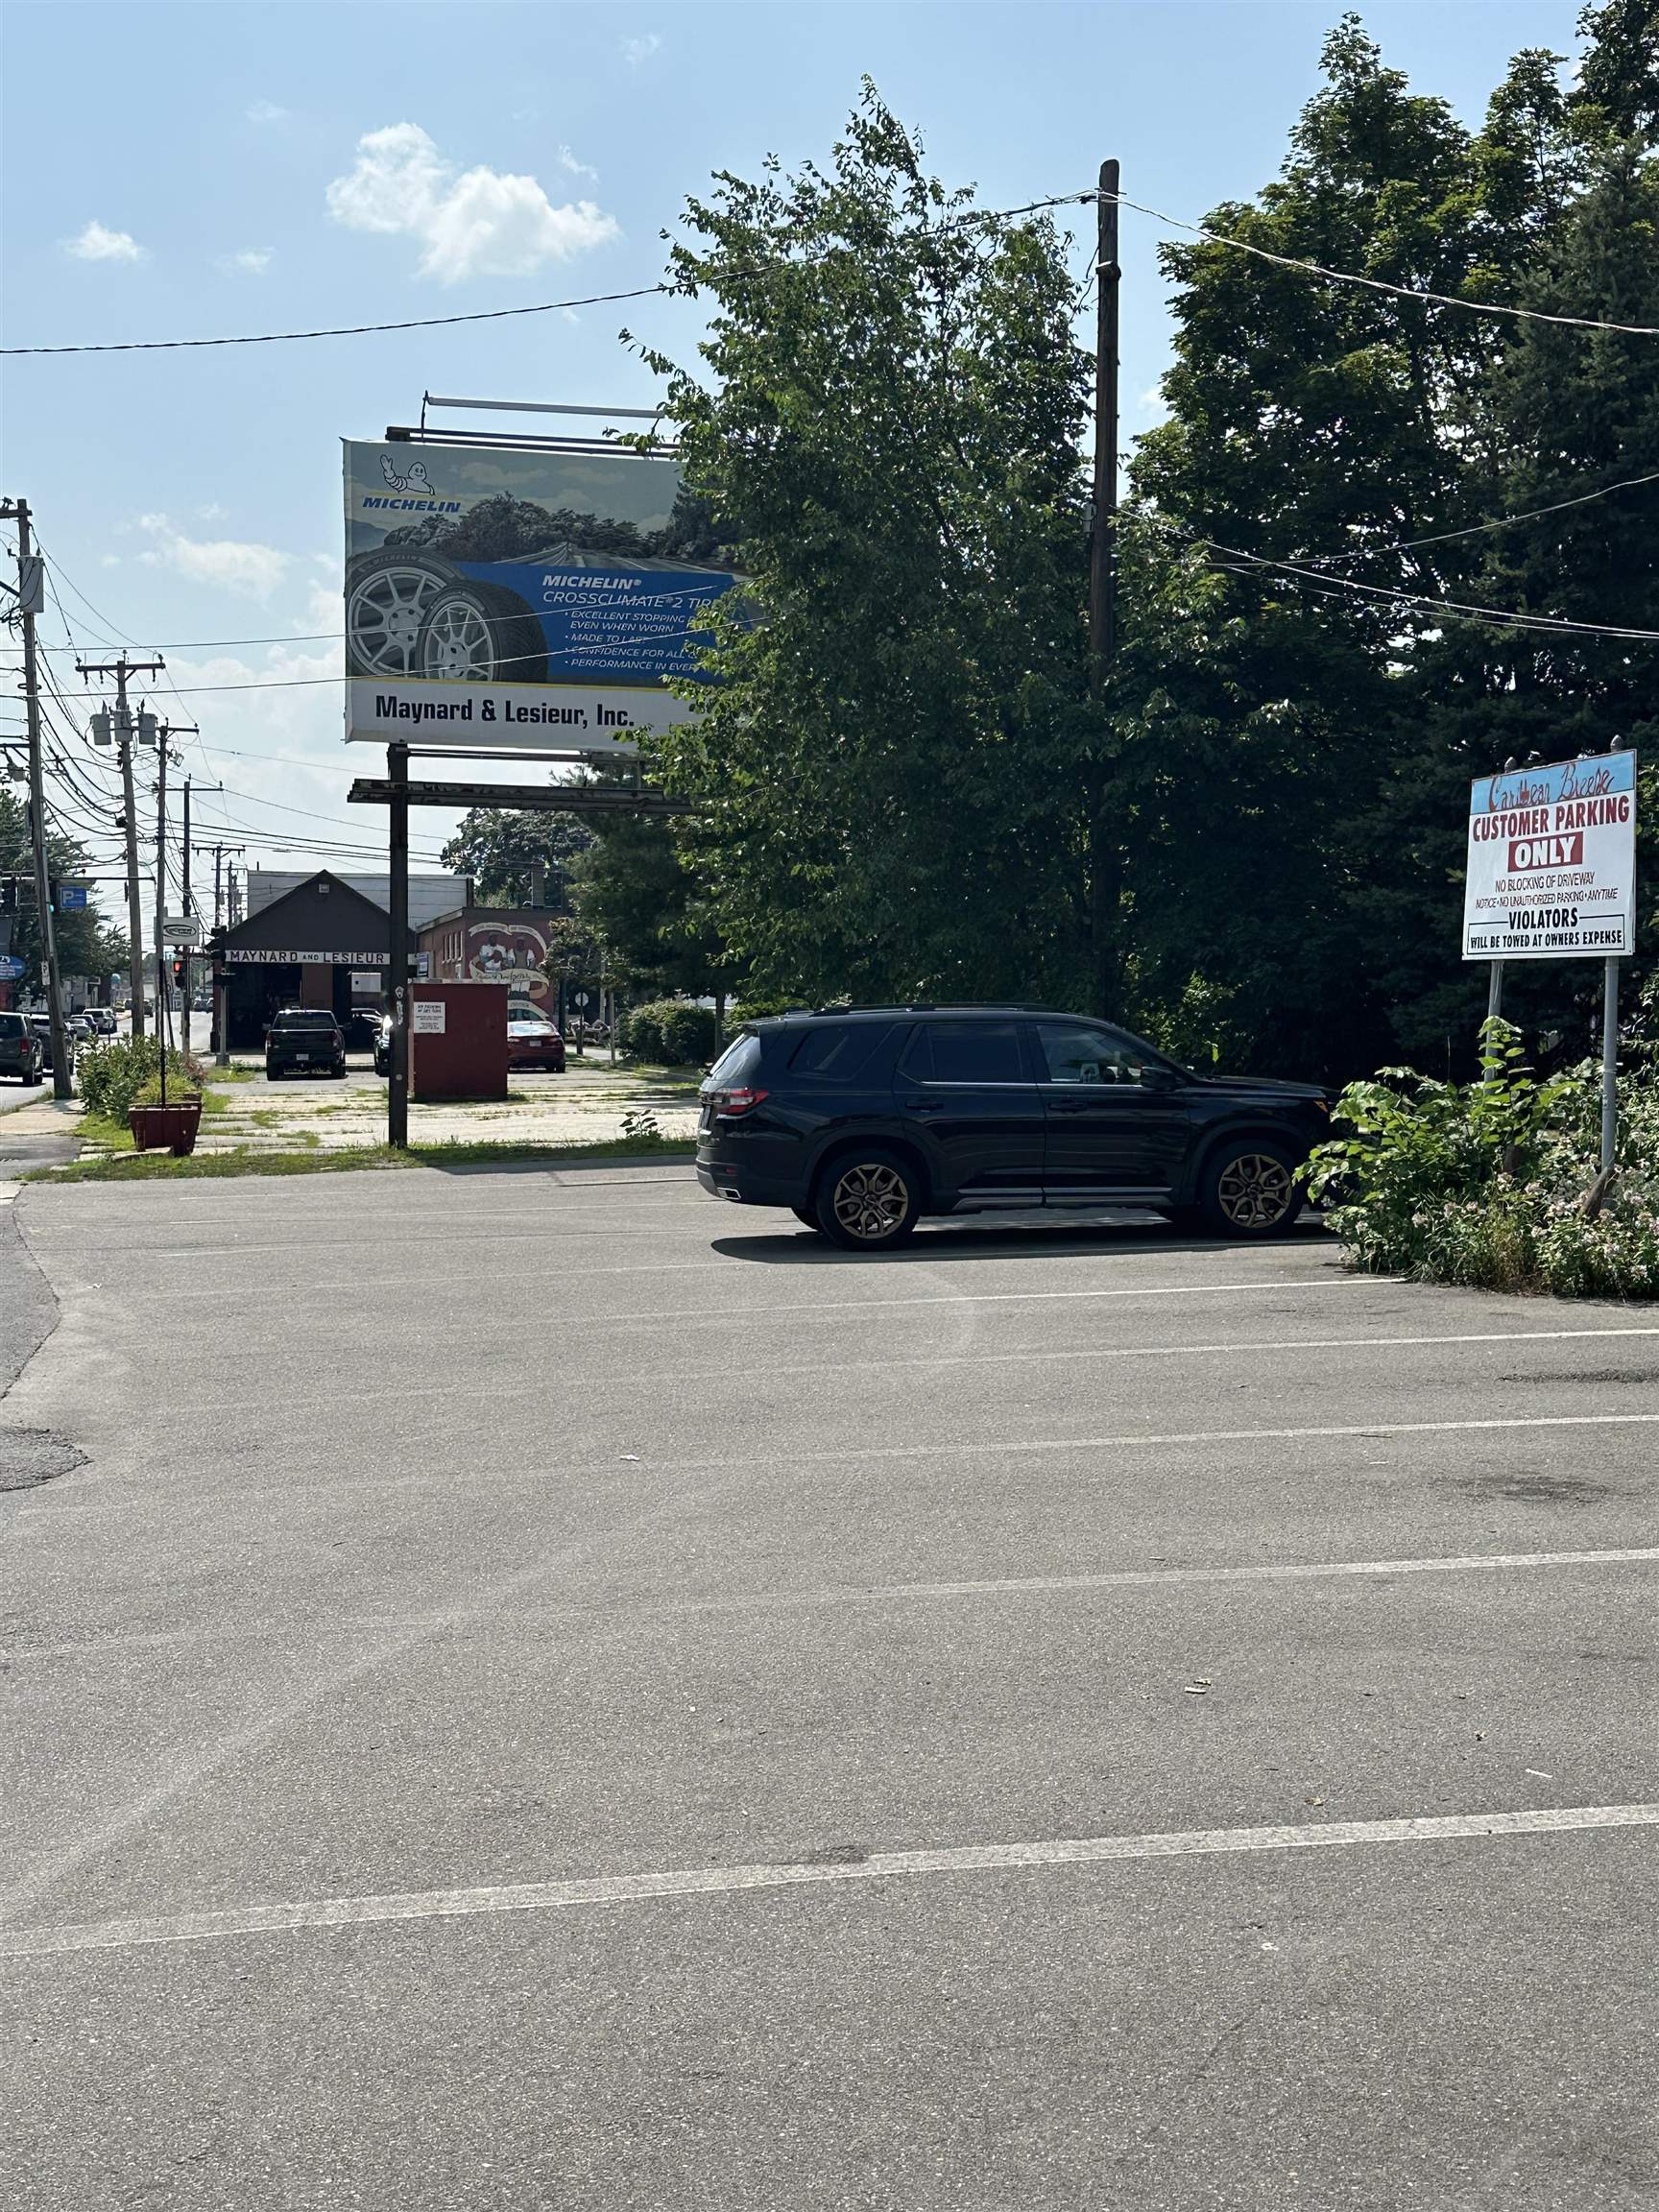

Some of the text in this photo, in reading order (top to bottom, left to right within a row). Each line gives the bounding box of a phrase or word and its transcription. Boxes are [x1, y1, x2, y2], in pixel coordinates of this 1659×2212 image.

[363, 497, 461, 513] MICHELIN
[688, 598, 712, 610] TIR
[571, 611, 631, 620] EXCELLENT
[633, 613, 685, 623] STOPPING
[570, 621, 674, 633] EVEN WHEN WORN
[570, 633, 603, 642] MADE
[606, 635, 619, 643] TO
[642, 649, 665, 659] FOR
[666, 650, 685, 660] ALL
[570, 659, 653, 670] PERFORMANCE
[655, 661, 666, 670] IN
[375, 695, 635, 730] Maynard & Lesieur, Inc.
[1473, 795, 1630, 842] CUSTOMER PARKING
[1514, 835, 1576, 869] ONLY
[1495, 871, 1596, 893] NO BLOCKING OF DRIVEWAY
[1476, 898, 1497, 909] NOTICE
[1500, 896, 1508, 906] NO
[1556, 890, 1584, 903] PARKING
[1587, 888, 1619, 902] ANYTIME
[1508, 907, 1578, 930] VIOLATORS
[1470, 930, 1623, 949] WILL BE TOWED AT OWNERS EXPENSE
[230, 950, 298, 962] MAYNARD
[324, 952, 385, 964] LESIEUR
